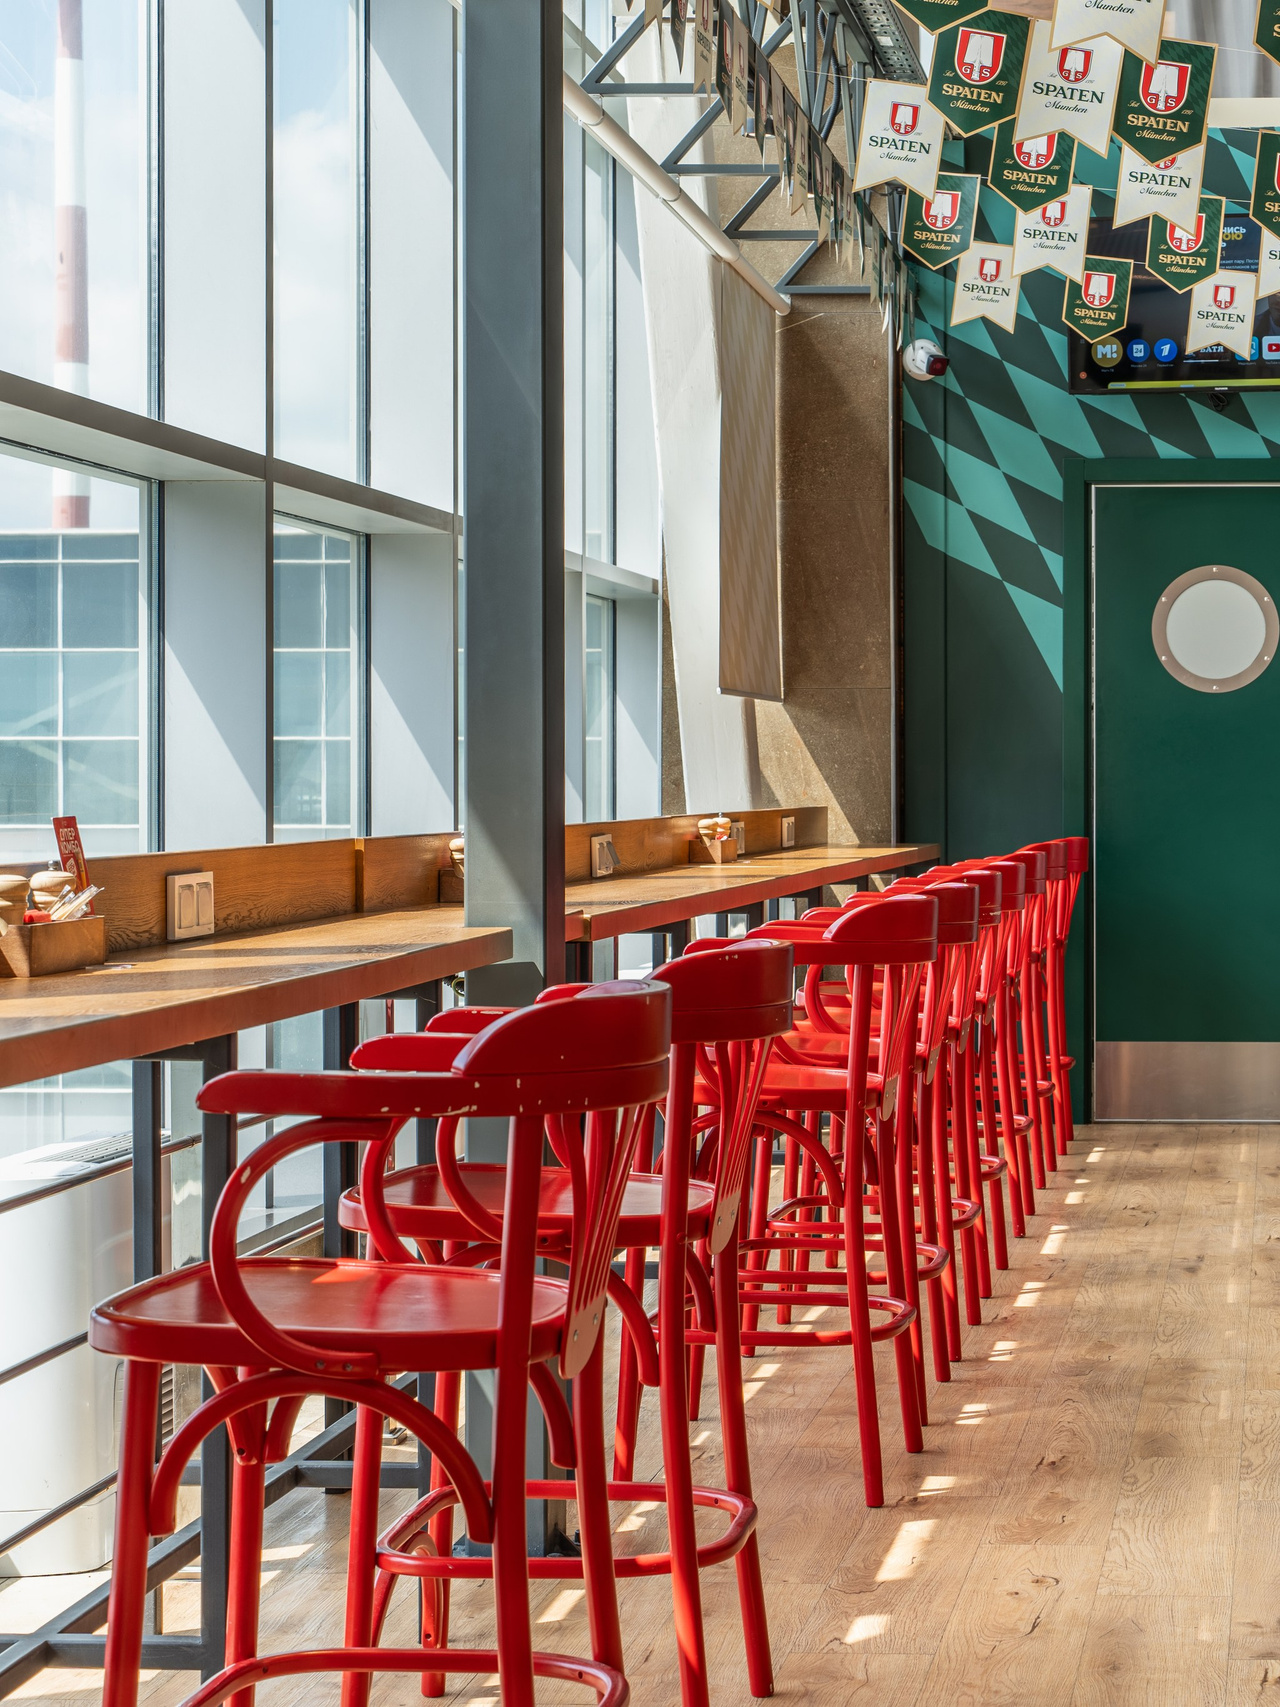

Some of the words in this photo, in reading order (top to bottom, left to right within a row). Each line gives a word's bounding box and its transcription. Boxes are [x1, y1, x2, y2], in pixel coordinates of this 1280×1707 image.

[942, 84, 1004, 104] SPATEN
[1032, 82, 1104, 104] SPATEN
[950, 100, 990, 112] München
[1127, 114, 1190, 133] SPATEN
[1136, 130, 1176, 142] München
[868, 136, 932, 154] SPATEN
[1002, 170, 1058, 186] SPATEN
[1128, 171, 1191, 189] SPATEN
[1010, 183, 1046, 194] München
[914, 230, 961, 243] SPATEN
[1023, 228, 1078, 243] SPATEN
[1158, 254, 1207, 266] SPATEN
[962, 283, 1010, 297] SPATEN
[1074, 308, 1116, 320] SPATEN
[1197, 310, 1246, 323] SPATEN
